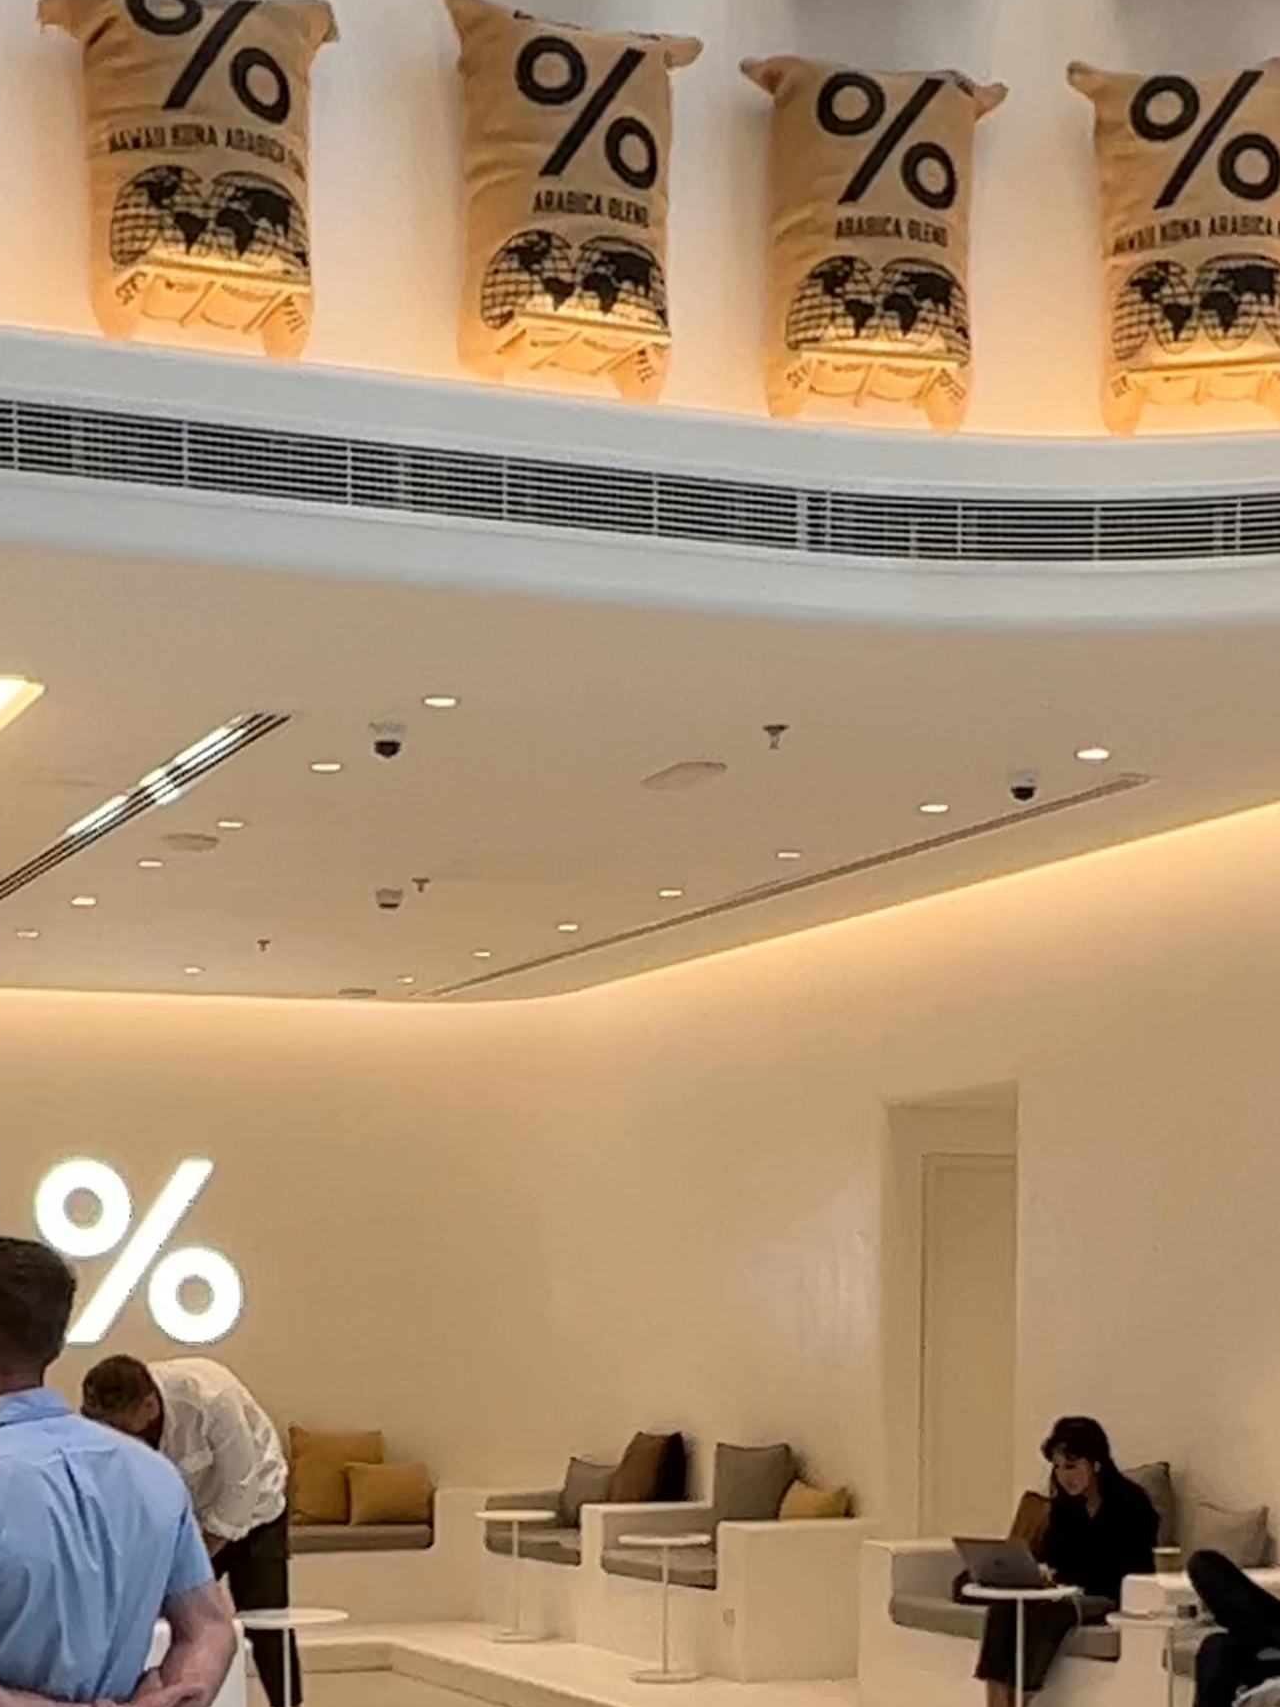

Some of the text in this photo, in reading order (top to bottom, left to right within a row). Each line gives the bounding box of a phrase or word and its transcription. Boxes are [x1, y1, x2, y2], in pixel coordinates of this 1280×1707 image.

[224, 129, 285, 161] ARABICA
[533, 191, 601, 215] ARABICA
[836, 216, 902, 241] ARABICA
[1208, 216, 1273, 238] ARABICA
